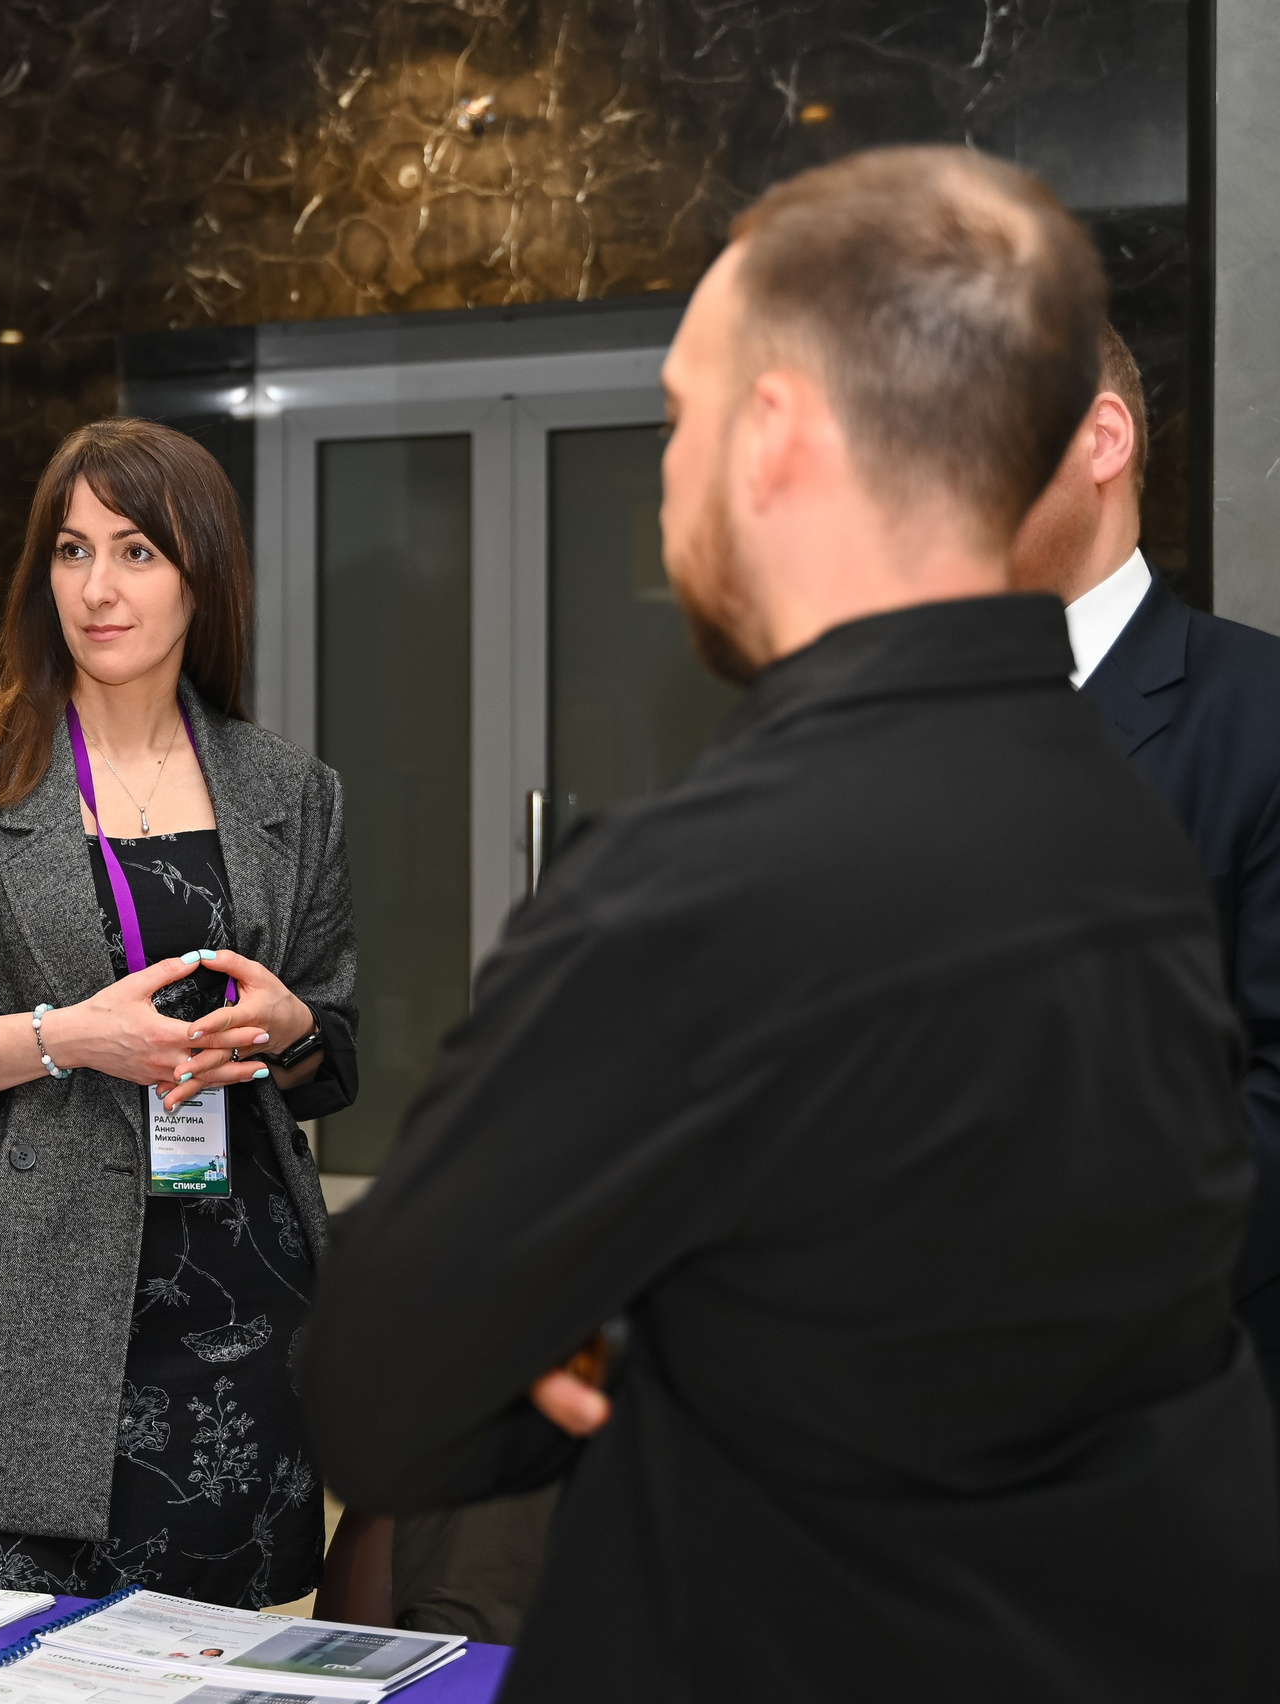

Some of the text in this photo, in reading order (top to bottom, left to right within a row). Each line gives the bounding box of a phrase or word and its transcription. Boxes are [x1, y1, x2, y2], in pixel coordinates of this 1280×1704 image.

[154, 1116, 204, 1124] РАЛДУГИНА
[154, 1125, 175, 1133] Анна
[154, 1134, 205, 1142] Михайловна
[173, 1182, 207, 1191] СПИКЕР
